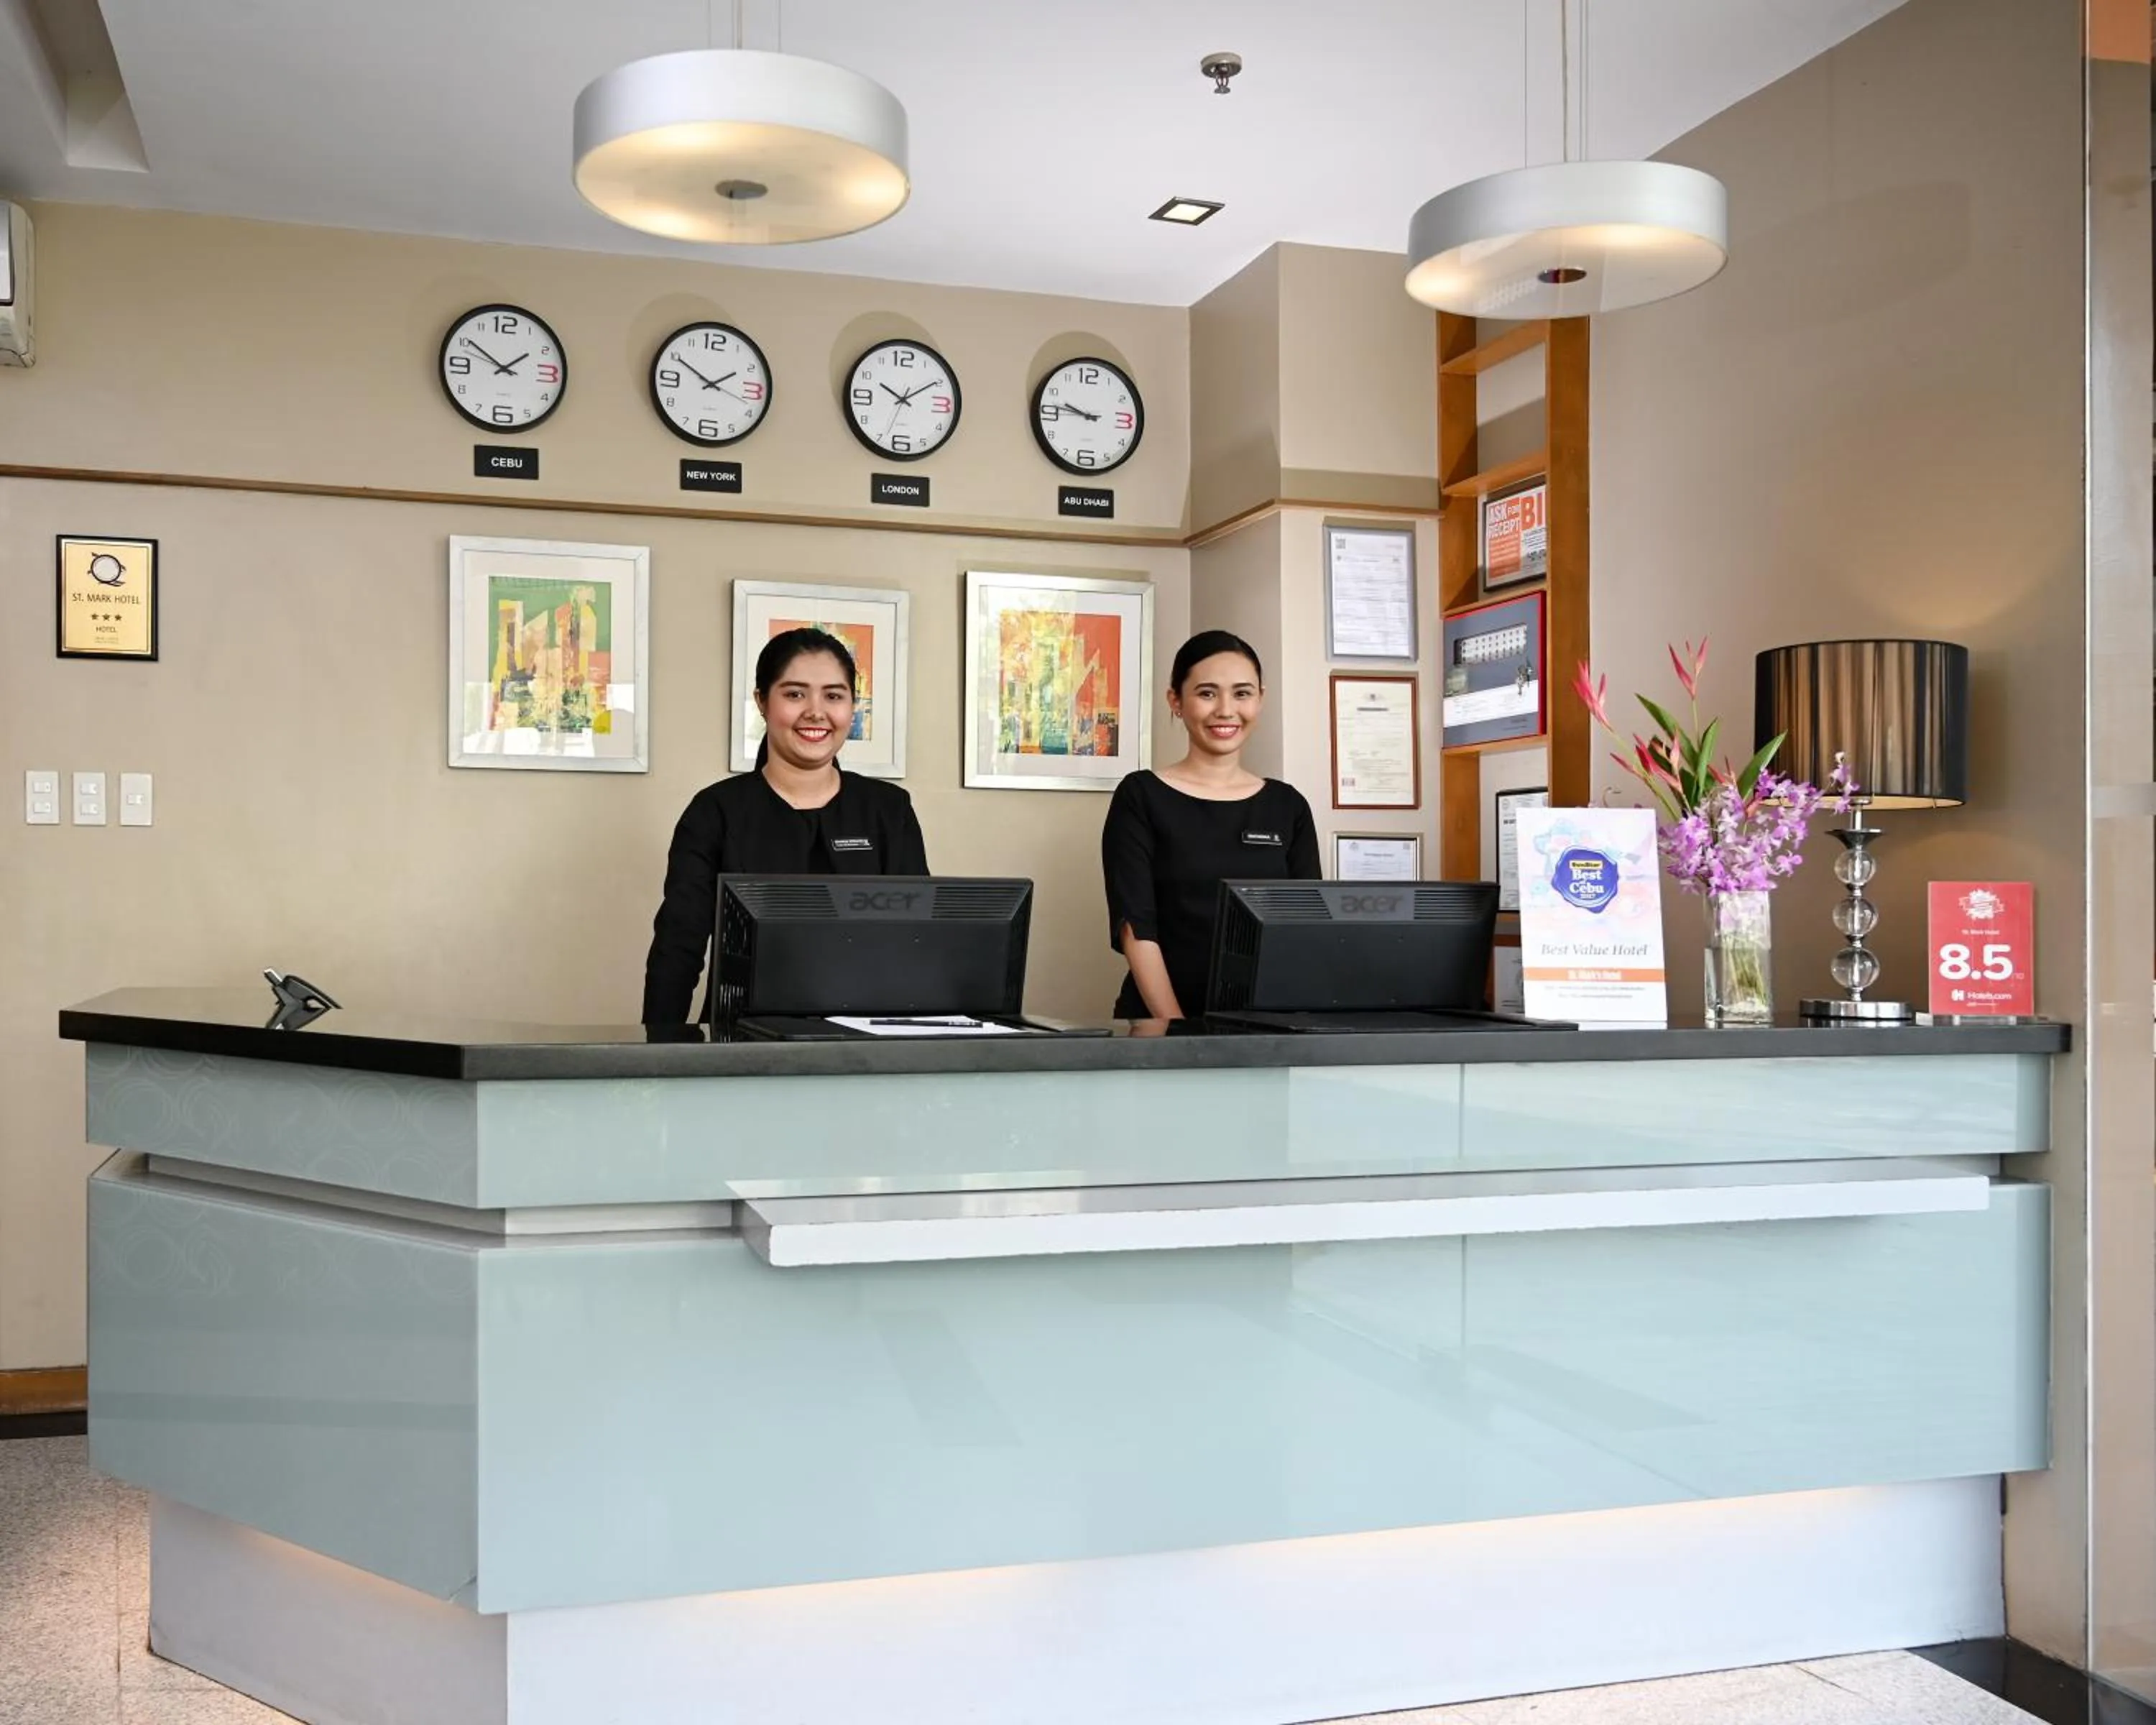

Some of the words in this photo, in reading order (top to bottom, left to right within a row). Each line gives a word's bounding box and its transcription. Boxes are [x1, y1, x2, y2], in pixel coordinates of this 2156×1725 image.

[478, 322, 485, 331] 11
[494, 315, 518, 335] 12
[459, 337, 469, 347] 10
[688, 338, 695, 348] 11
[704, 333, 727, 351] 12
[541, 346, 550, 355] 2
[671, 351, 681, 362] 10
[878, 356, 885, 365] 11
[893, 350, 915, 368] 12
[449, 356, 471, 374] 9
[747, 364, 755, 373] 2
[536, 364, 558, 383] 3
[660, 370, 680, 388] 9
[862, 370, 872, 380] 10
[1064, 373, 1072, 382] 11
[1079, 367, 1099, 385] 12
[935, 379, 944, 387] 2
[458, 385, 466, 395] 8
[742, 381, 763, 400] 3
[1049, 387, 1059, 396] 10
[540, 393, 549, 402] 4
[666, 397, 675, 407] 8
[853, 389, 872, 405] 9
[1118, 395, 1126, 404] 2
[475, 403, 482, 413] 7
[931, 396, 951, 413] 3
[492, 405, 513, 423] 6
[523, 409, 531, 418] 5
[745, 409, 753, 418] 4
[1041, 405, 1059, 421] 9
[682, 416, 689, 426] 7
[860, 415, 868, 425] 8
[1115, 412, 1133, 429] 3
[699, 419, 718, 438] 6
[728, 423, 735, 433] 5
[936, 423, 942, 431] 4
[876, 433, 883, 442] 7
[1048, 431, 1055, 440] 8
[892, 435, 911, 452] 6
[919, 438, 926, 447] 5
[1063, 448, 1069, 457] 7
[1077, 449, 1095, 466] 6
[1103, 454, 1110, 462] 5
[491, 457, 522, 468] CEBU
[686, 471, 708, 480] NEW
[709, 472, 736, 482] YORK
[882, 484, 920, 495] LONDON
[1064, 496, 1082, 505] ABU
[1083, 497, 1110, 507] DHABI
[1488, 502, 1506, 524] ASK
[1488, 519, 1519, 538] RECEIPT
[73, 593, 84, 602] ST.
[87, 593, 111, 602] MARK
[115, 594, 139, 604] HOTEL
[1572, 870, 1603, 880] Best
[1569, 882, 1605, 893] Cebu
[849, 891, 921, 911] acer
[1340, 895, 1402, 914] acer
[1542, 944, 1569, 956] Best
[1573, 944, 1609, 956] Value
[1612, 944, 1649, 956] Hotel
[1939, 943, 2013, 980] 8.5
